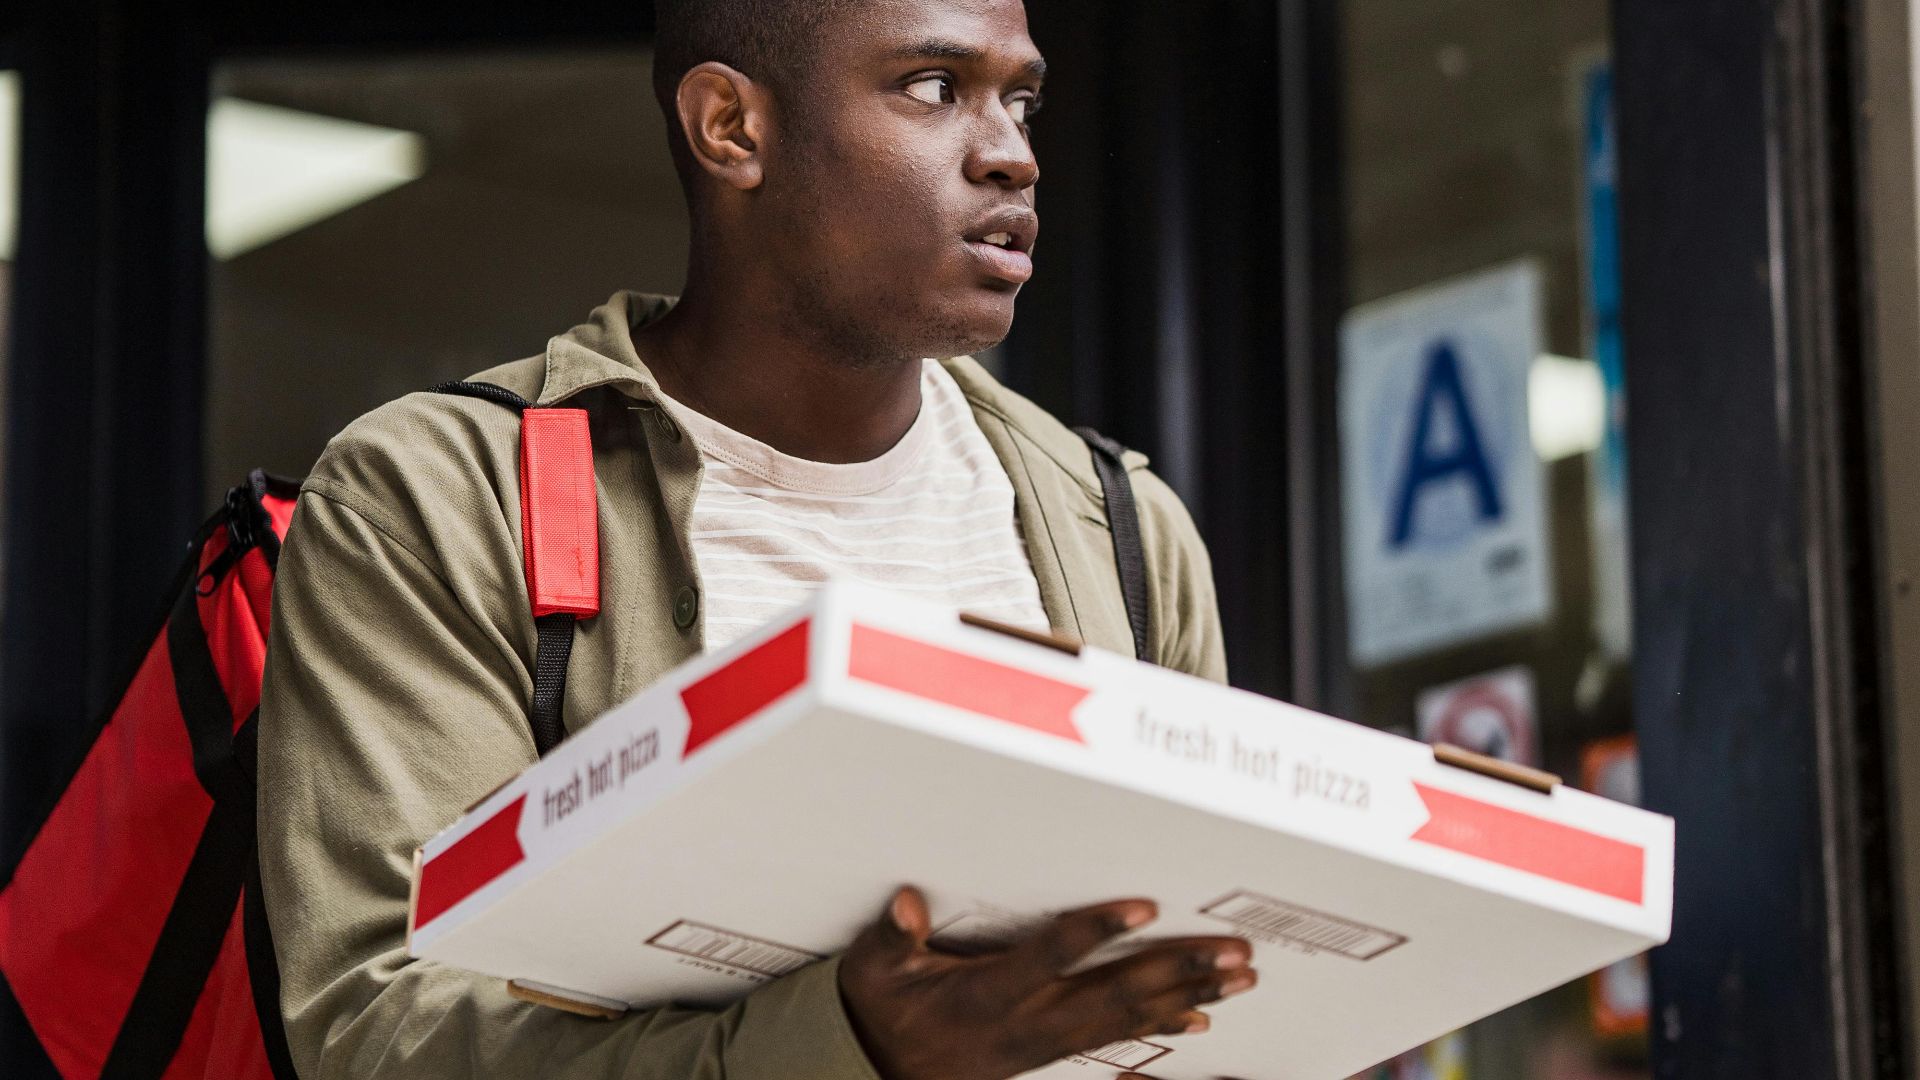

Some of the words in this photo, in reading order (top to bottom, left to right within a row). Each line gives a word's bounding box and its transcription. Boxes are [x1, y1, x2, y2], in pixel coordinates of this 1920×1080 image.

[1386, 339, 1503, 552] A
[544, 769, 583, 828] fresh
[588, 751, 613, 799] hot
[619, 728, 659, 787] pizza
[1135, 708, 1217, 766] fresh
[1231, 733, 1279, 782] hot
[1294, 755, 1370, 810] pizza
